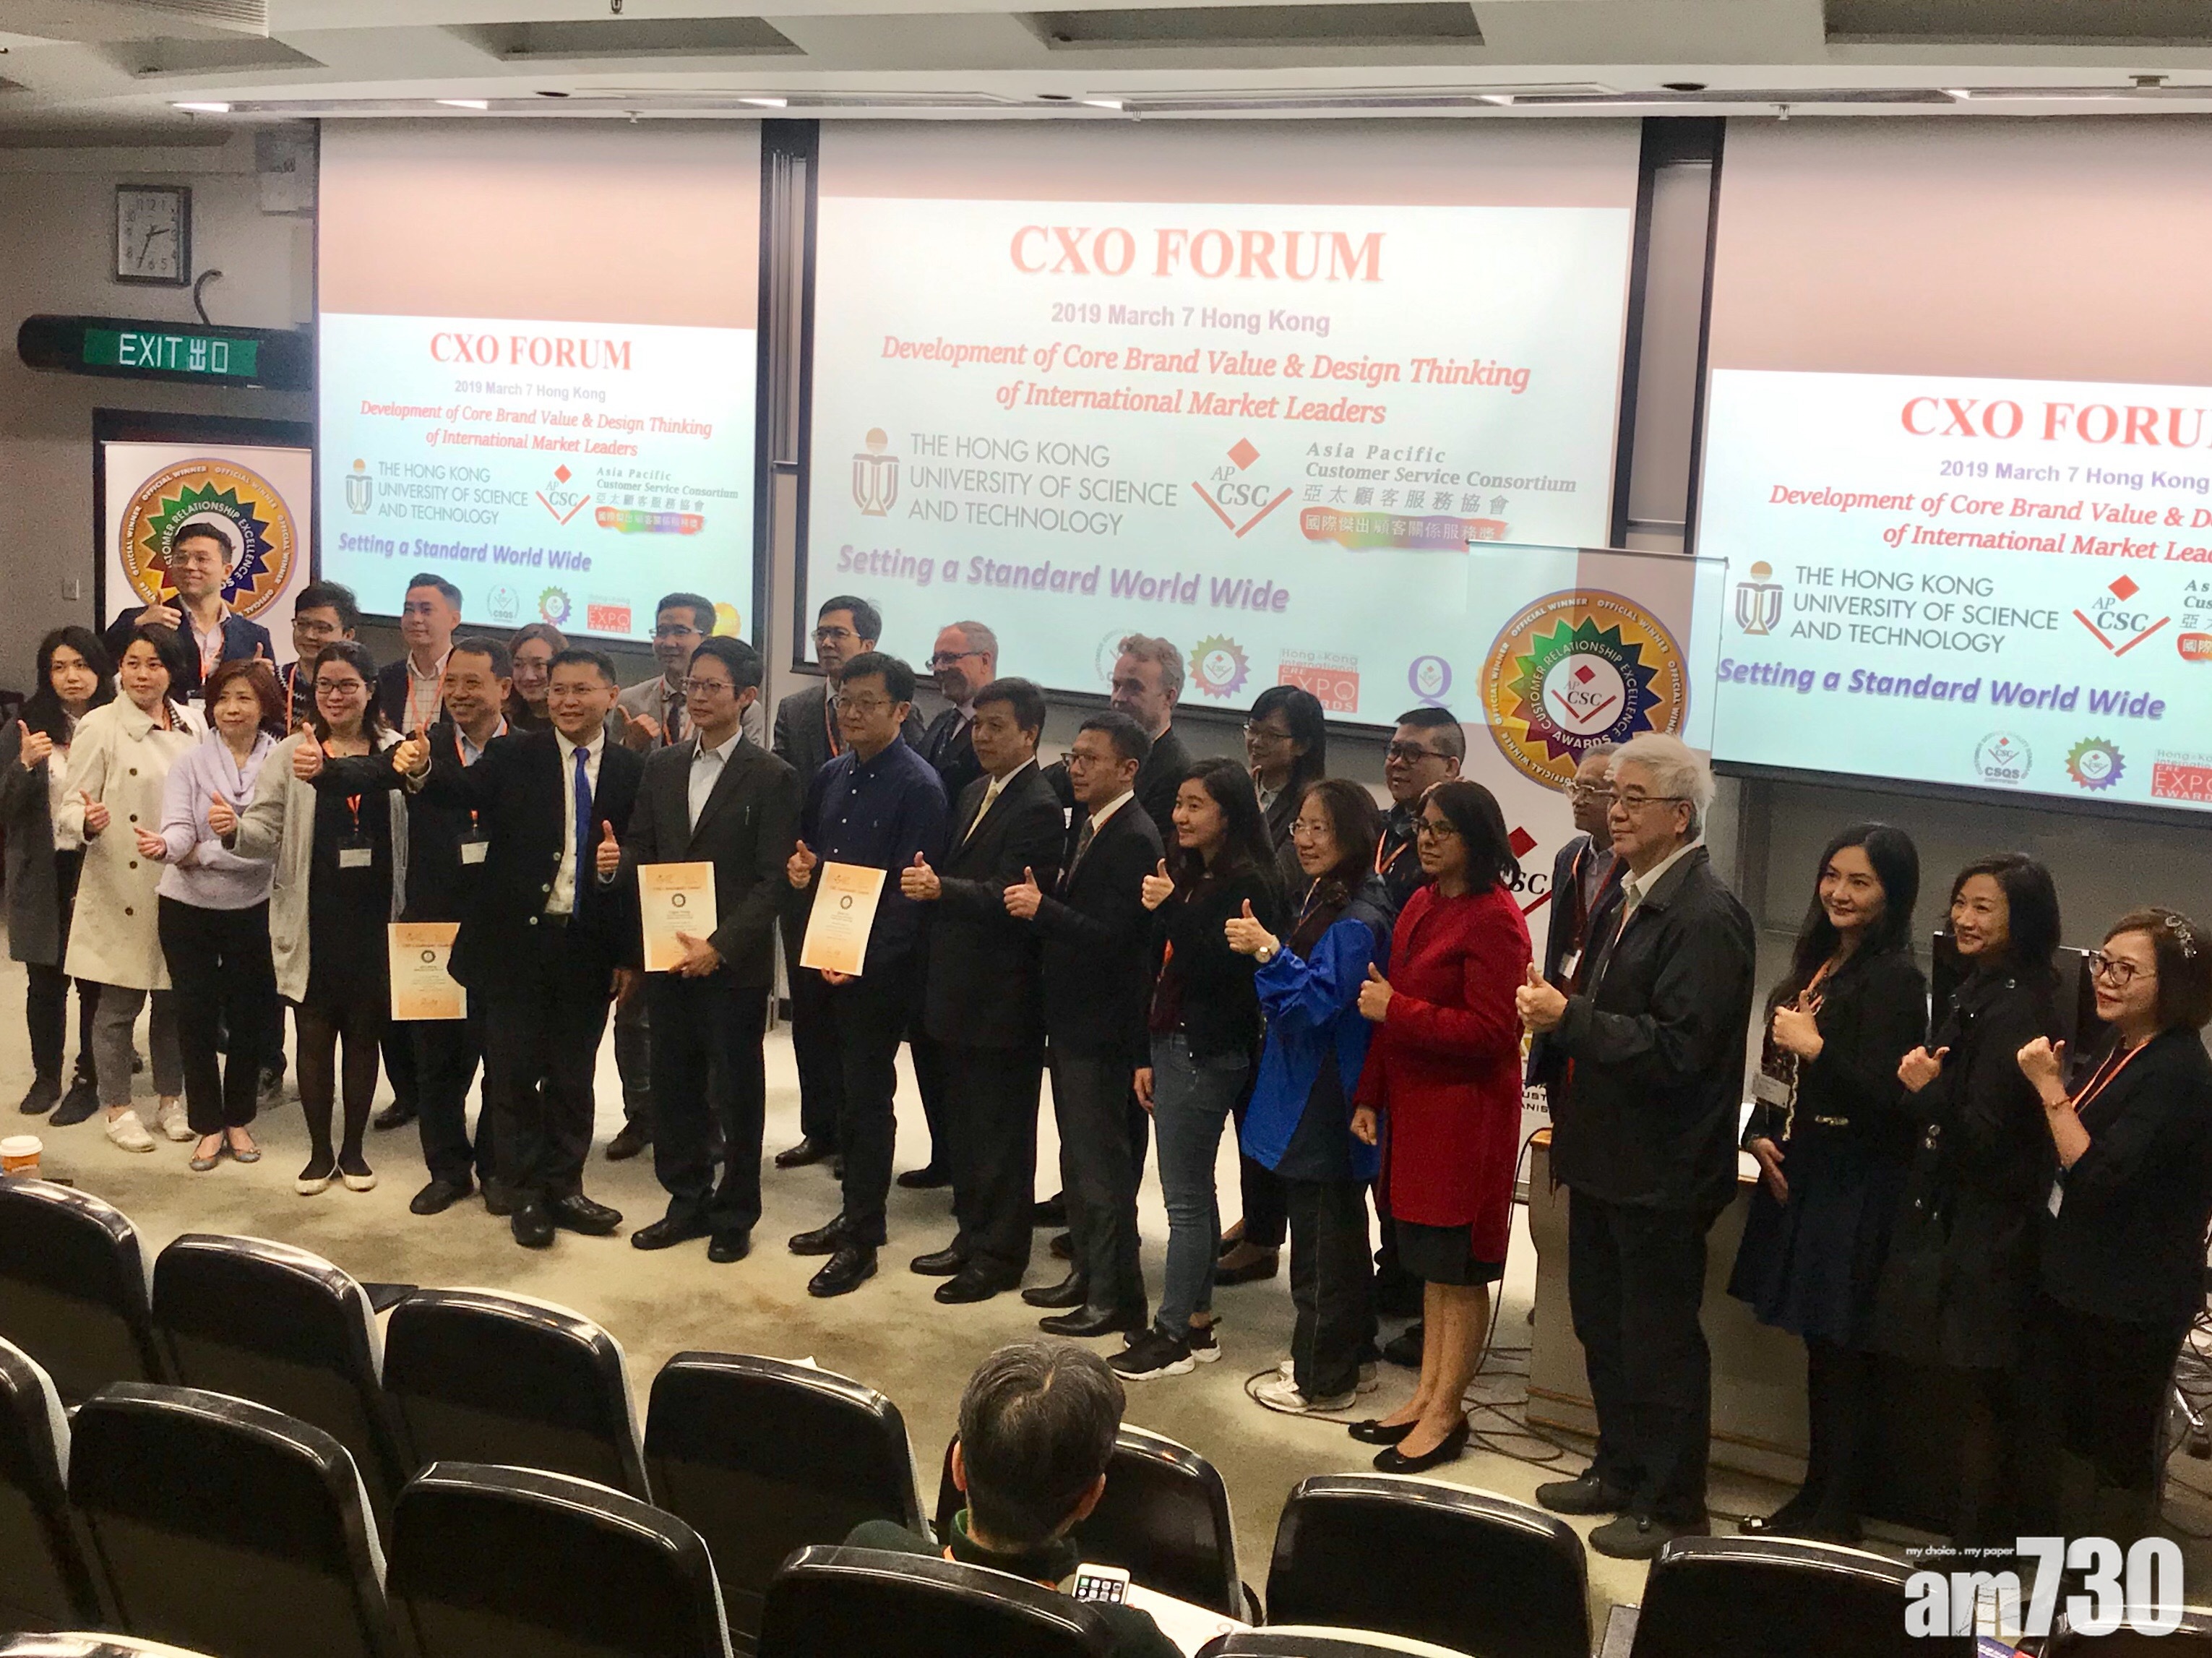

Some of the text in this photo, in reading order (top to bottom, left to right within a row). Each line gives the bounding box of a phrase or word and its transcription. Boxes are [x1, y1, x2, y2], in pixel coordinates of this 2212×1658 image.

[1010, 225, 1386, 282] CXO FORUM
[1051, 302, 1330, 338] 2019 March 7 Hong Kong
[119, 333, 183, 369] EXIT
[189, 338, 228, 373] 出口
[430, 332, 632, 370] CXO FORUM
[881, 336, 1531, 395] Development of Core Brand Value & Design Thinking
[454, 379, 606, 403] 2019 March 7 Hong Kong
[996, 381, 1386, 424] of International Market Leaders
[361, 400, 713, 439] Development of Core Brand Value & Design Thinking
[1901, 396, 2212, 450] CXO FORU
[426, 429, 638, 456] of International Market Leaders
[910, 433, 1111, 468] THE HONG KONG
[1307, 441, 1446, 464] Asia Pacific
[142, 465, 207, 501] OFFICIAL WINNER
[215, 466, 278, 510] OFFICIAL WINNER
[378, 461, 491, 483] THE HONG KONG
[596, 466, 672, 481] Asia Pacific
[596, 478, 739, 499] Customer Service Consortium
[910, 465, 1179, 507] UNIVERSITY OF SCIENCE
[1210, 465, 1236, 482] AP
[1306, 462, 1577, 494] Customer Service Consortium
[1940, 460, 2211, 495] 2019 March 7 Hong Kong
[378, 482, 528, 507] UNIVERSITY OF SCIENCE
[548, 491, 579, 507] CSC
[1216, 483, 1270, 508] CSC
[1302, 483, 1509, 516] 亞太顧客服務協會
[1769, 484, 2185, 527] Development of Core Brand Value &
[378, 502, 499, 525] AND TECHNOLOGY
[908, 499, 1124, 536] AND TECHNOLOGY
[171, 501, 255, 580] RELATIONSHIP EXCELLENCE
[338, 532, 593, 572] Setting a Standard World Wide
[1882, 524, 2160, 559] of International Market
[837, 544, 1289, 611] Setting a Standard World Wide
[1795, 565, 1994, 598] THE HONG KONG
[1511, 598, 1588, 637] OFFICIAL WINNER
[1793, 593, 2059, 631] UNIVERSITY OF SCIENCE
[2091, 596, 2116, 610] AP
[1597, 599, 1669, 654] OFFICIAL WINNER
[1790, 620, 2005, 654] AND TECHNOLOGY
[2096, 611, 2149, 632] CSC
[1490, 642, 1510, 726] OFFICIAL WINNER
[1530, 640, 1638, 738] CUSTOMER RELATIONSHIP EXCELLENCE
[1567, 690, 1603, 707] CSC
[1668, 660, 1682, 704] OFFICIAL
[1717, 658, 2166, 720] Setting a Standard World Wide
[1320, 699, 1354, 711] RDS
[1552, 731, 1612, 749] AWARDS
[1984, 766, 2020, 779] CSQS
[1508, 871, 1548, 895] SC
